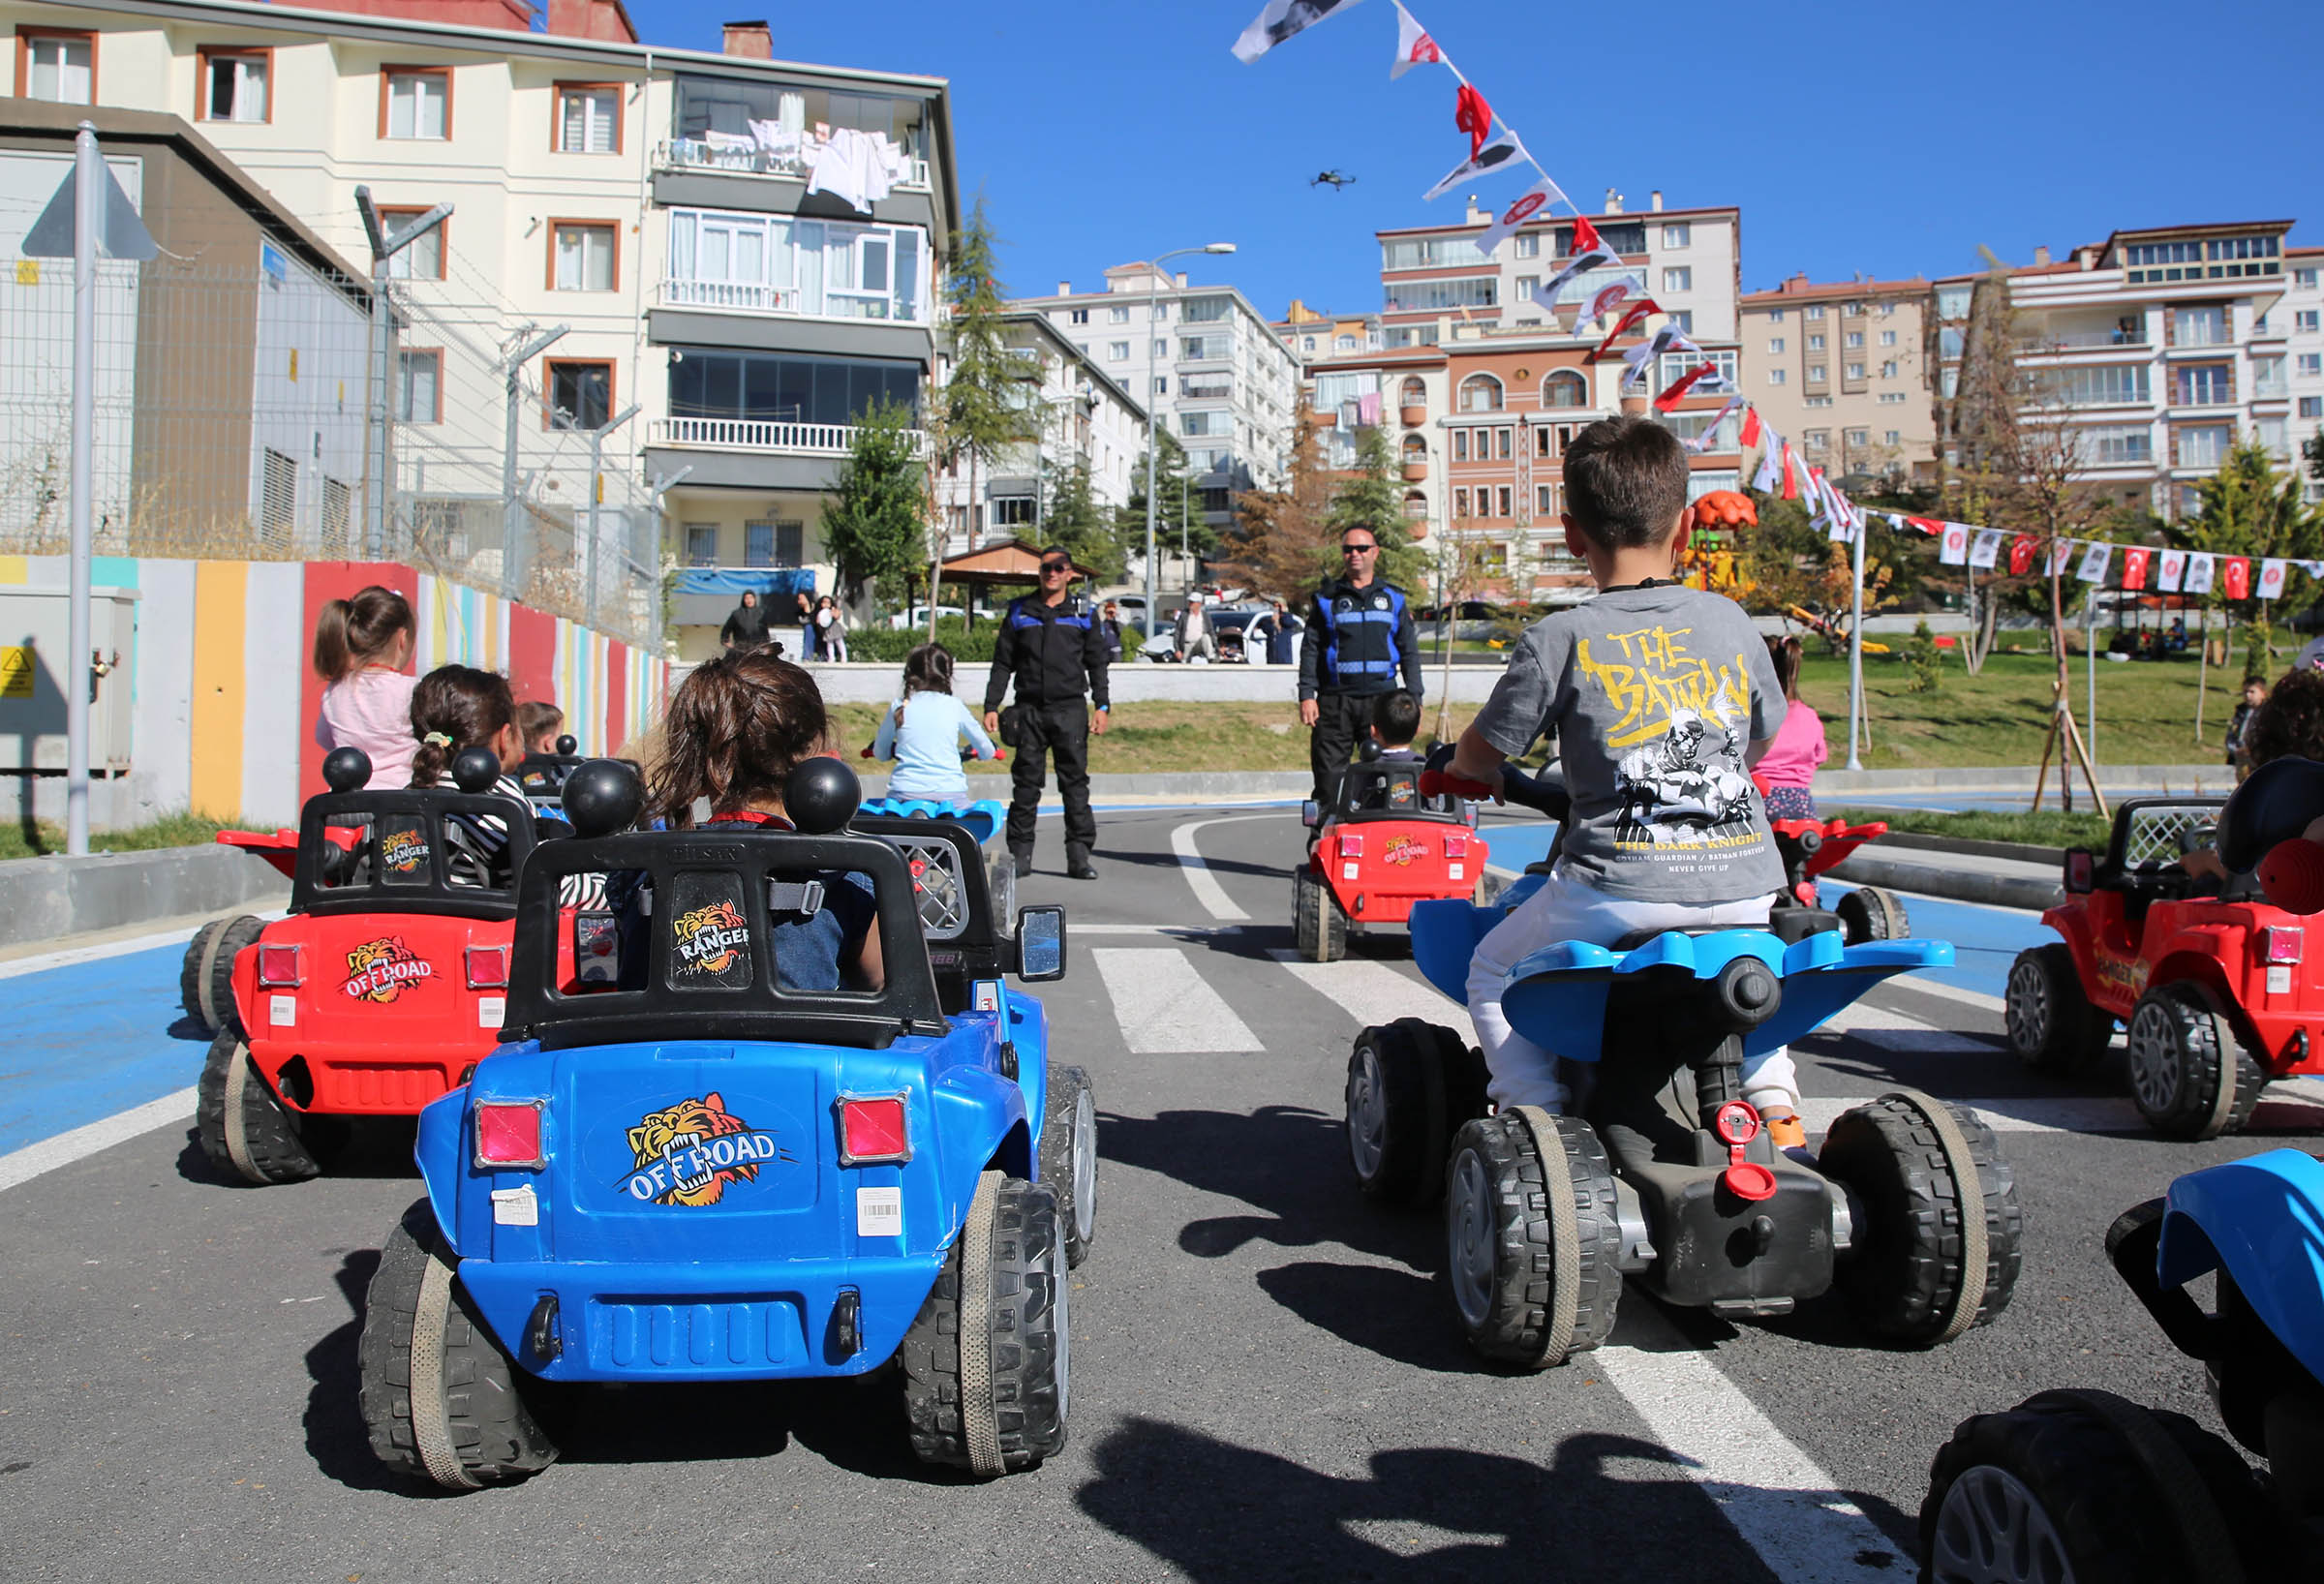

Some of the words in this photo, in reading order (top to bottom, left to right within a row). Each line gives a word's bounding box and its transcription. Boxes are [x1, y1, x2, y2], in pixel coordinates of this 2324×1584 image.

[1605, 625, 1698, 672] THE
[1577, 639, 1750, 733] BATMAN
[384, 844, 430, 865] RANGER
[1612, 841, 1651, 851] THE
[1654, 840, 1704, 851] DARK
[1706, 832, 1762, 850] KNIGHT
[1708, 851, 1738, 861] BATMAN
[347, 970, 380, 996] OFF
[381, 961, 432, 982] ROAD
[629, 1155, 685, 1201] OFF
[688, 1134, 776, 1173] ROAD
